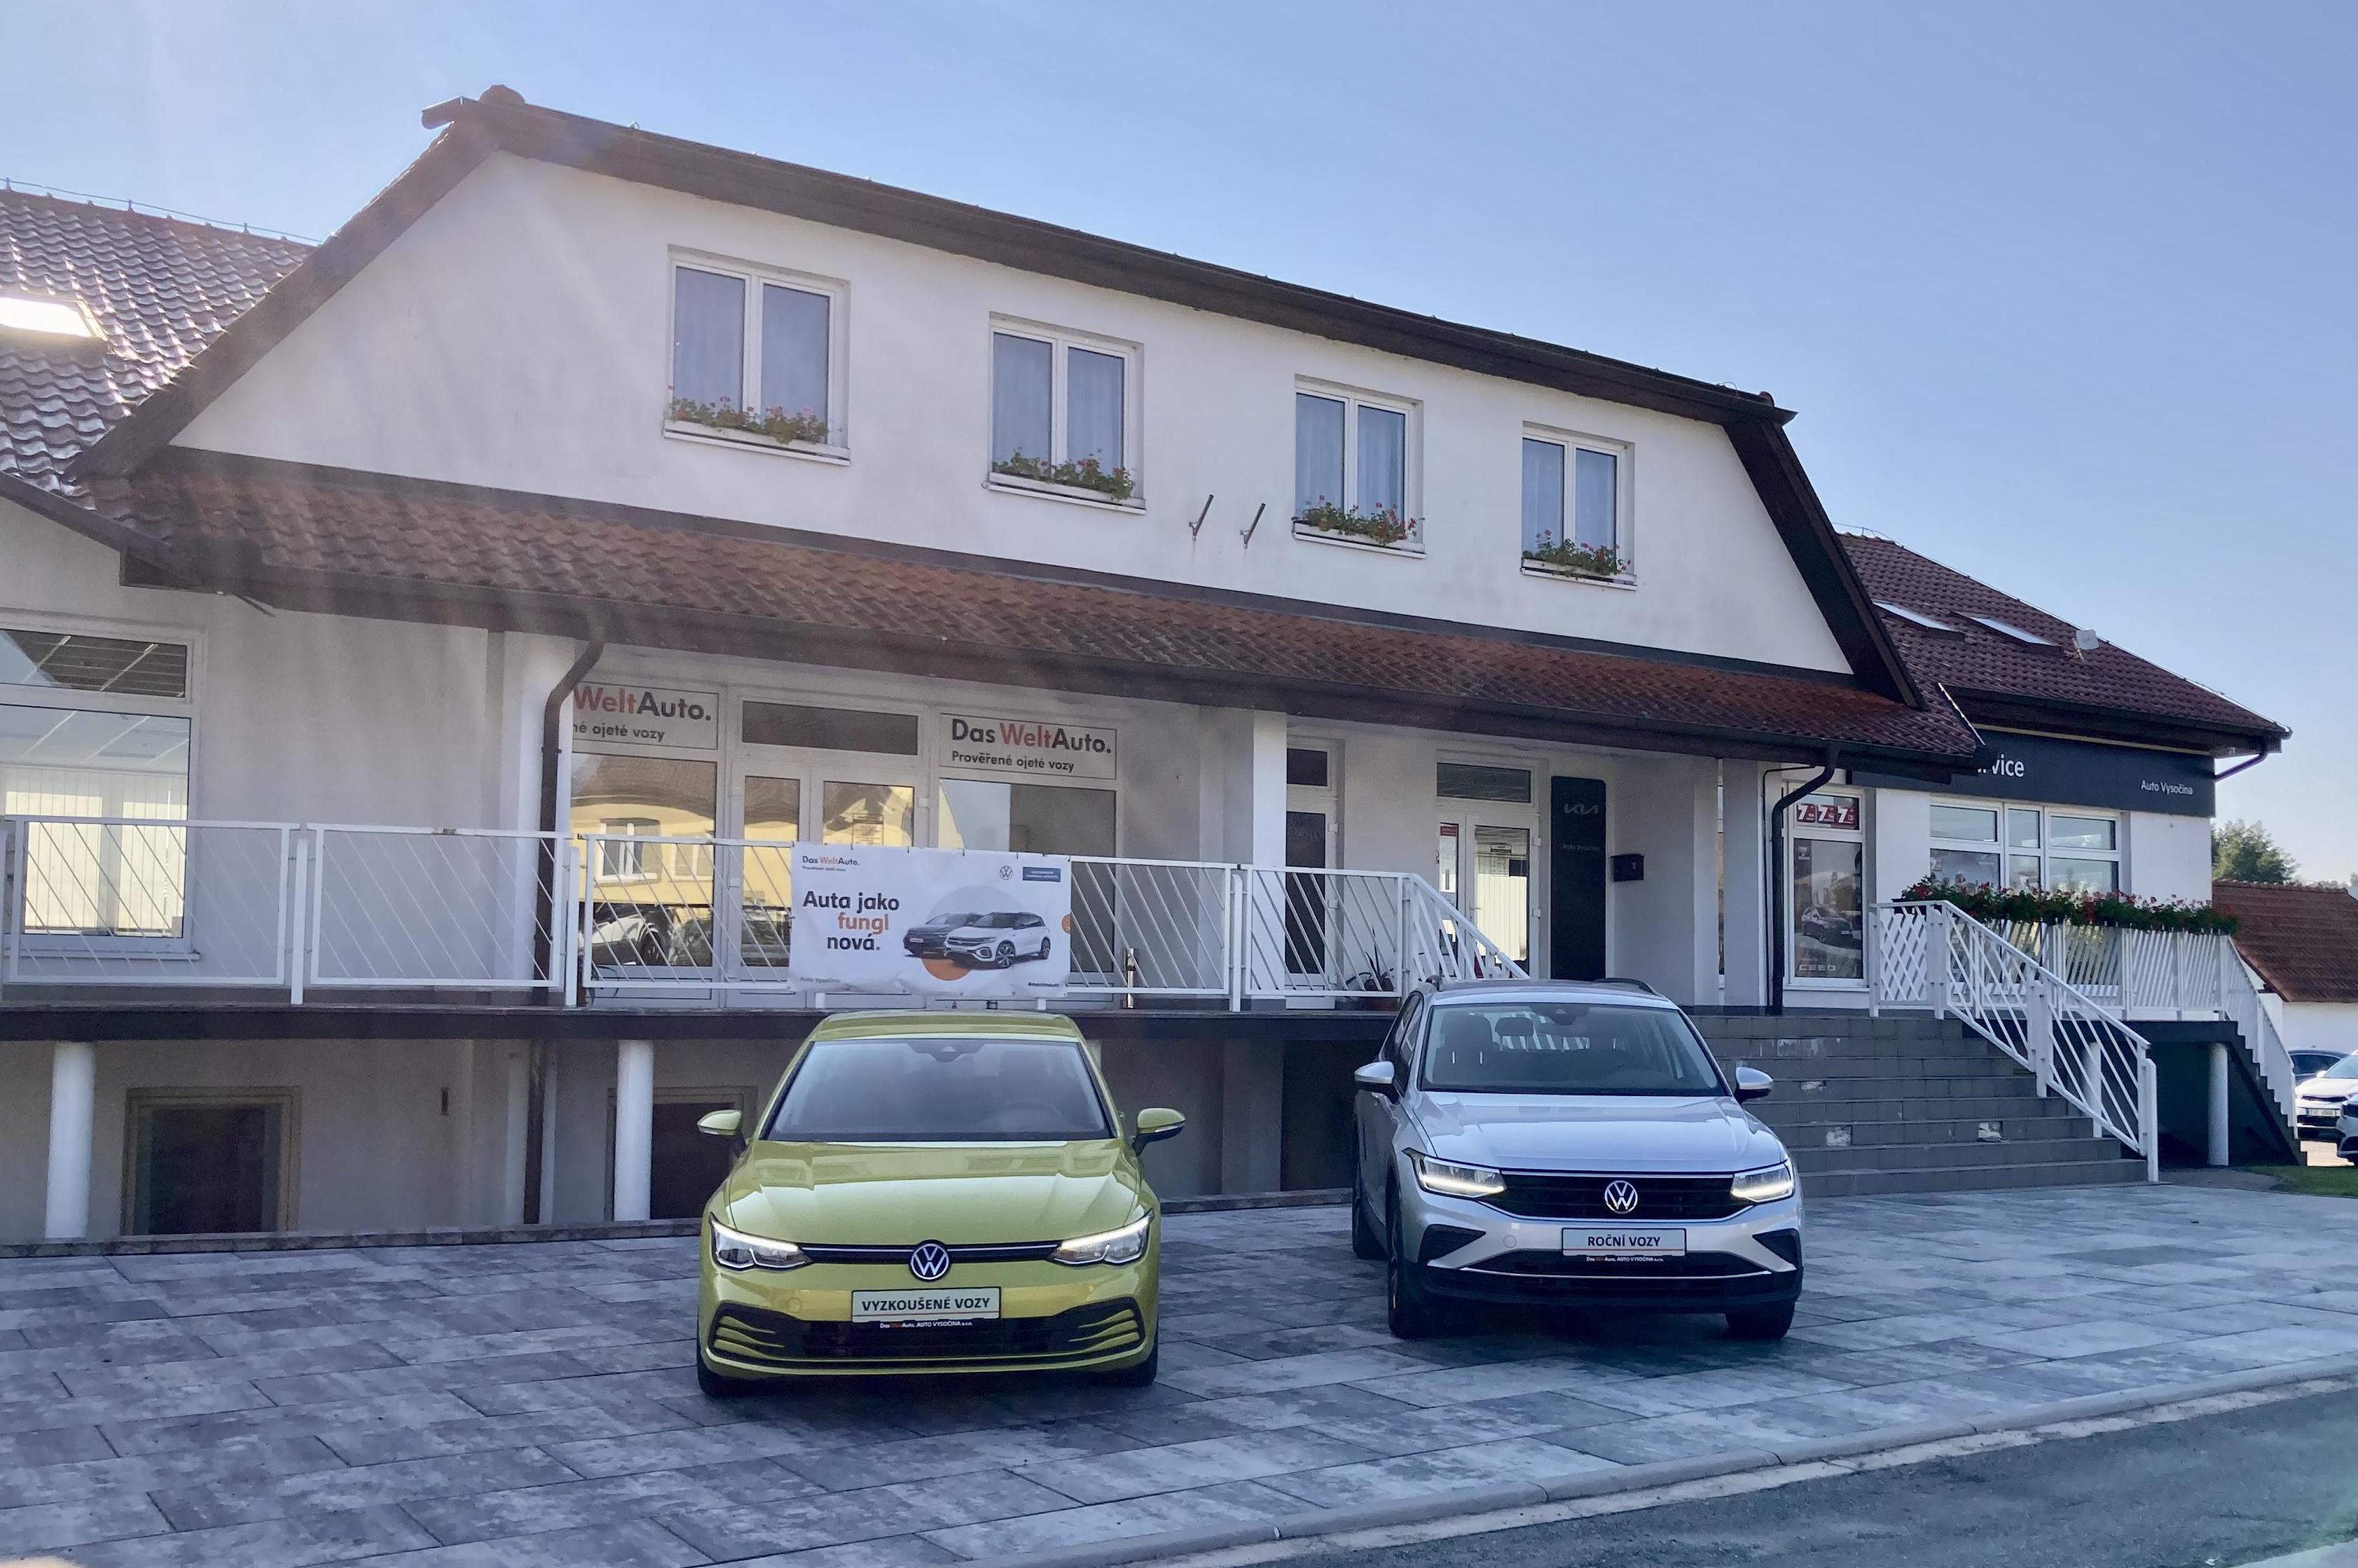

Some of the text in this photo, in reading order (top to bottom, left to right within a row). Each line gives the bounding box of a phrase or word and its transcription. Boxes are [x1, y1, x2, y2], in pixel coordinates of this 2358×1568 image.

[574, 686, 711, 721] WeltAuto.
[592, 722, 628, 738] ojeté
[633, 728, 666, 742] vozy
[952, 719, 1112, 754] Das WeltAuto.
[952, 751, 1075, 773] Prověřené ojeté vozy
[2141, 780, 2193, 795] Auto Vysočina
[802, 855, 860, 866] Das WeltAuto.
[803, 891, 899, 913] Auta jako
[837, 912, 889, 935] fungl
[827, 933, 881, 951] nová.
[1587, 1234, 1661, 1247] ROČNÍ VOZY
[862, 1296, 991, 1312] VYZKOUŠENÉ VOZY
